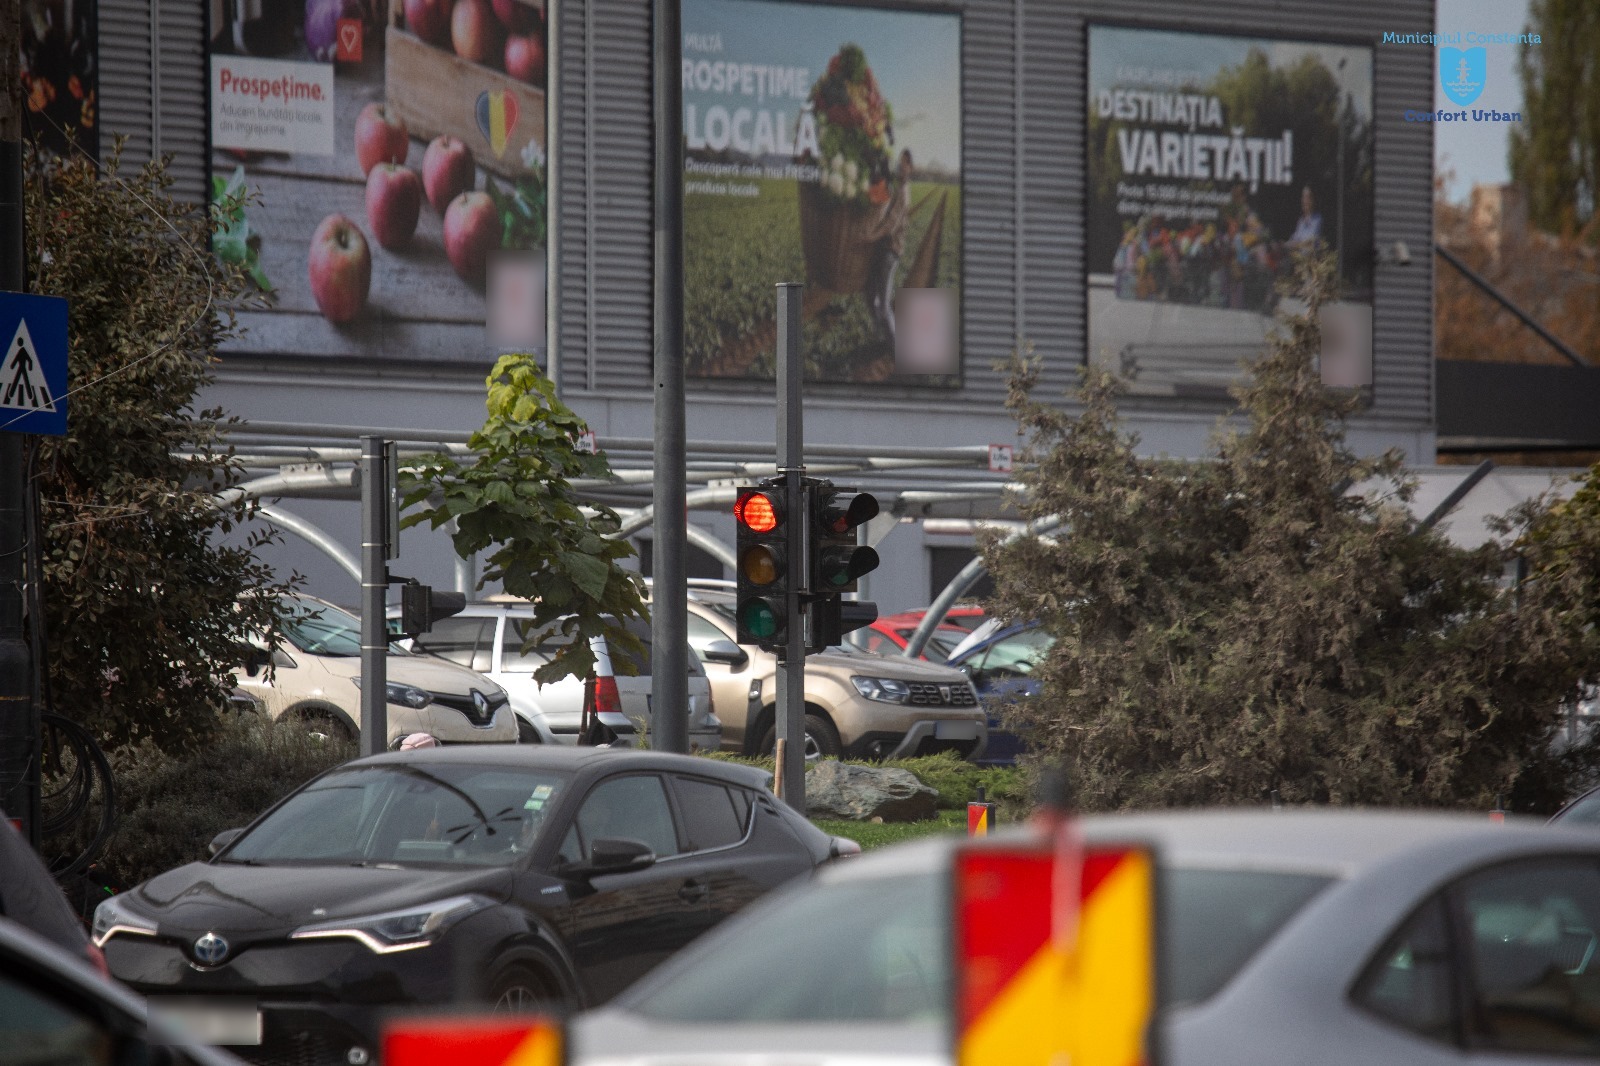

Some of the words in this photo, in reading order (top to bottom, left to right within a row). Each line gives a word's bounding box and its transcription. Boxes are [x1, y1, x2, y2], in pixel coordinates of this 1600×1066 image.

[219, 67, 326, 105] Prospețime.
[681, 58, 809, 105] ROSPEȚIME
[685, 101, 821, 158] LOCALĂ
[1098, 89, 1224, 132] DESTINAȚIA
[1117, 126, 1294, 196] VARIETĂȚII!
